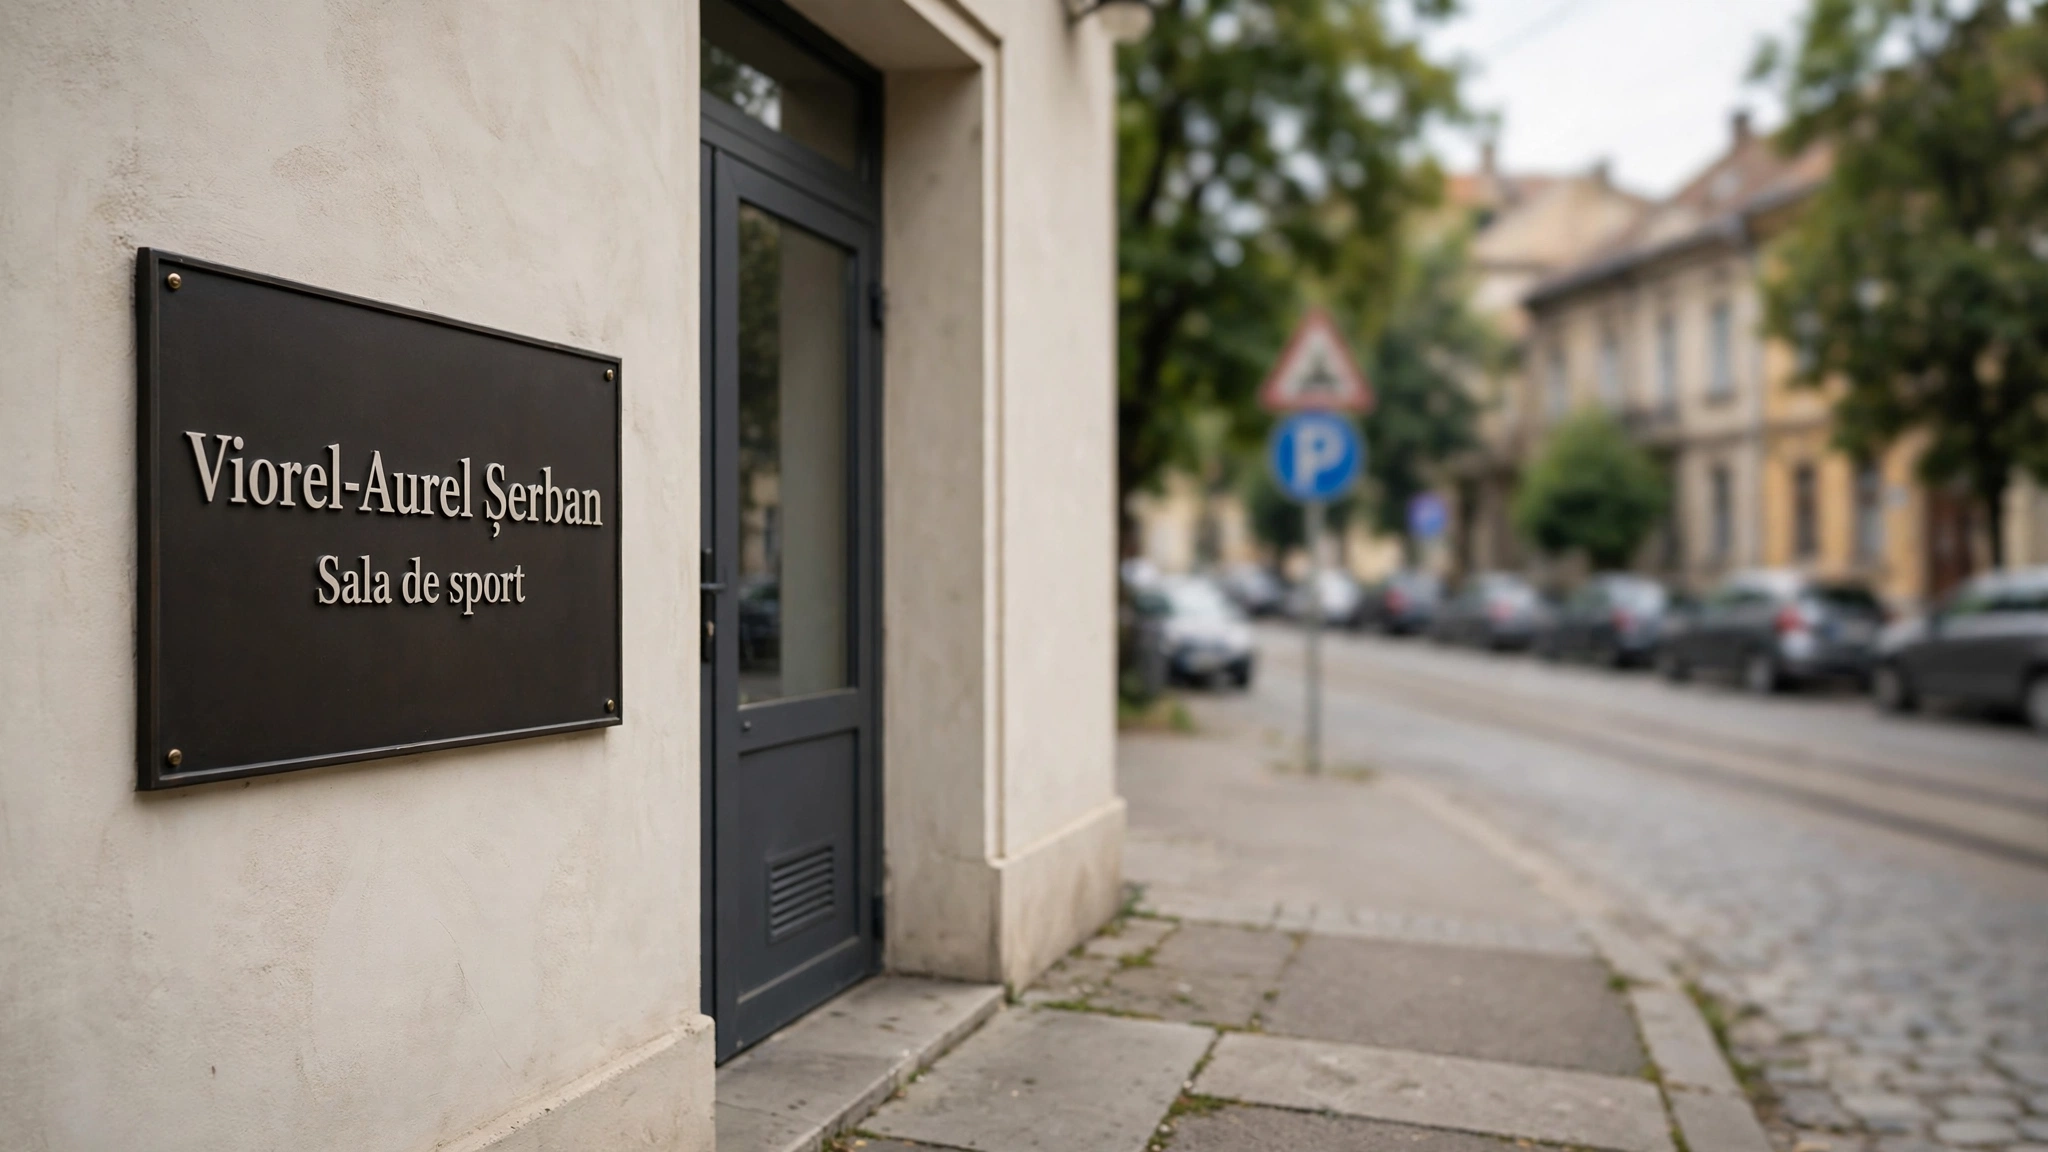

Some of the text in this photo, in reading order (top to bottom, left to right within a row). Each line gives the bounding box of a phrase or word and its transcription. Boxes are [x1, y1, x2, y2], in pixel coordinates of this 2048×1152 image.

[184, 430, 603, 537] Viorel-Aurel Șerban
[1294, 422, 1346, 493] P
[317, 554, 526, 616] Sala de sport
